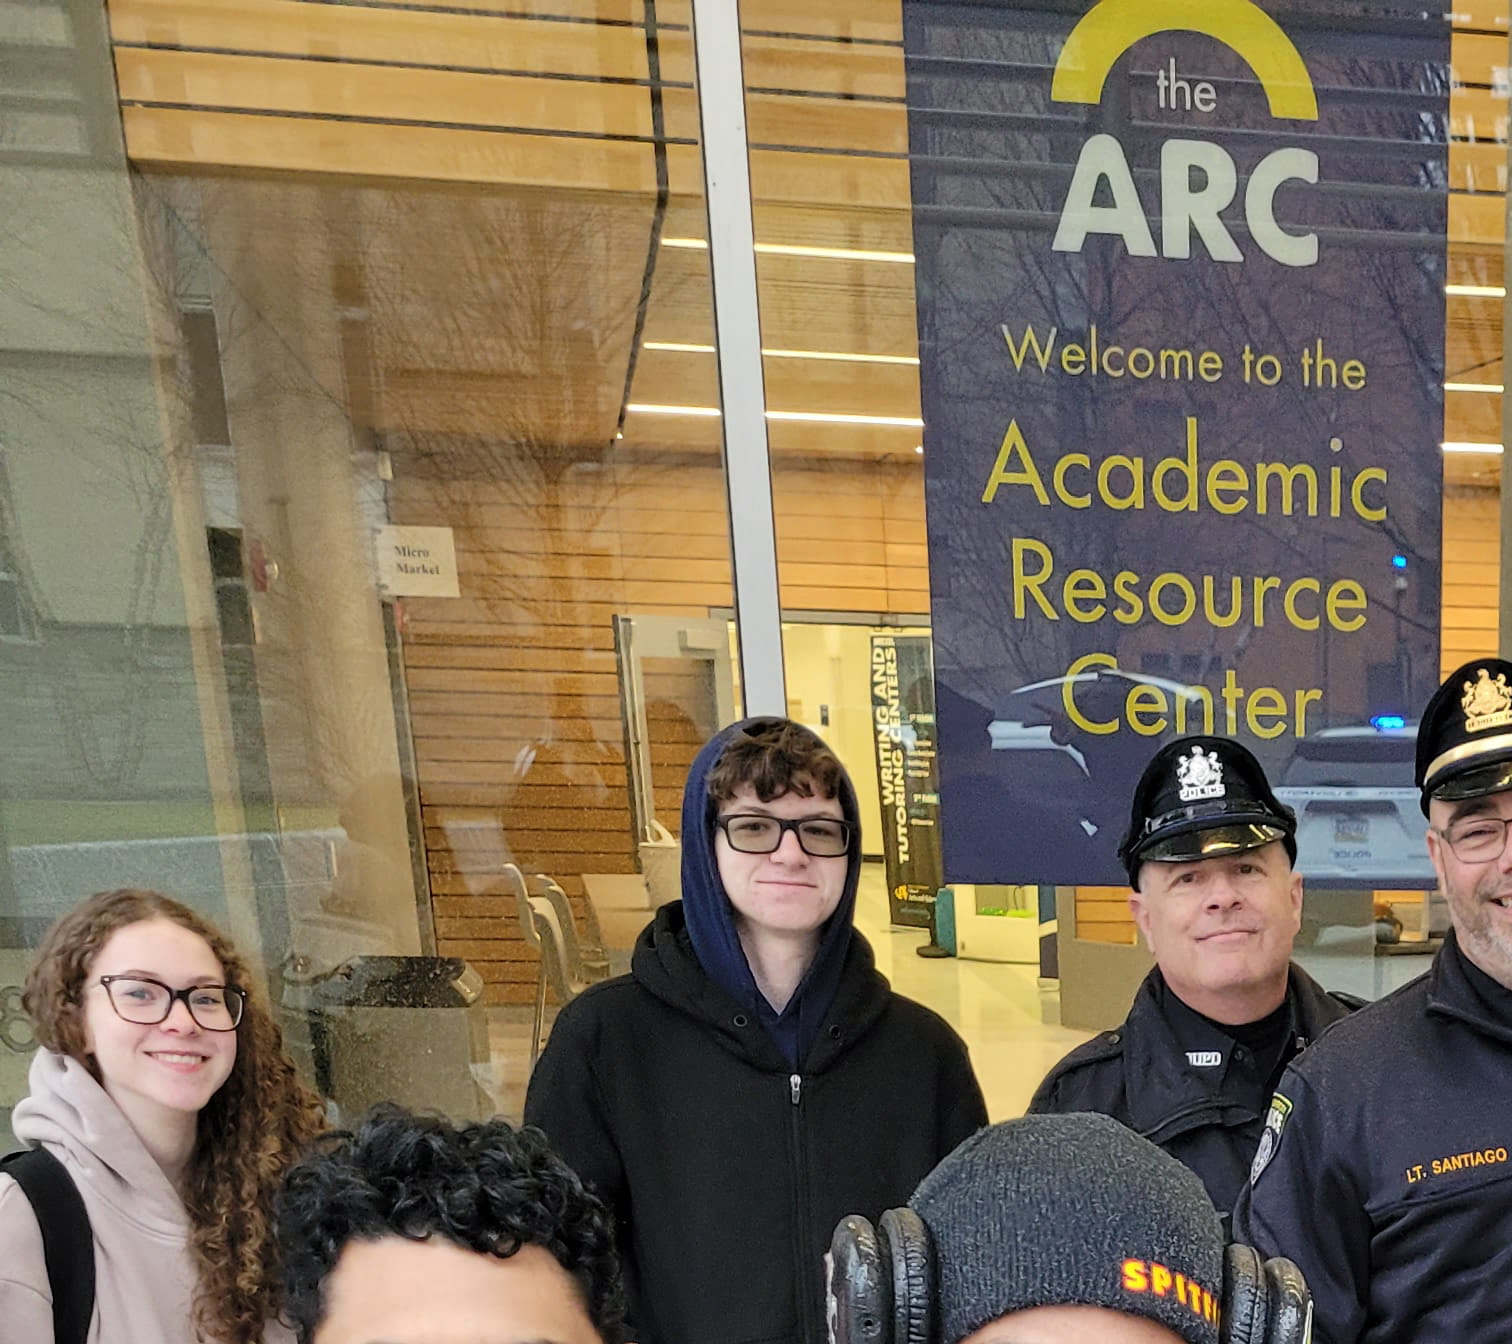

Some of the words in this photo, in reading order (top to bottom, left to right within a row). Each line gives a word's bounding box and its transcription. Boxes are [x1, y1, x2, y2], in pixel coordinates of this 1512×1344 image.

[1156, 57, 1217, 112] the
[1051, 134, 1319, 266] ARC
[1001, 324, 1223, 382] Welcome
[1243, 345, 1283, 386] to
[1301, 338, 1367, 390] the
[981, 417, 1389, 522] Academic
[394, 545, 430, 558] Micro
[396, 563, 441, 575] Market
[1011, 537, 1369, 633] Resource
[873, 652, 888, 699] AND
[886, 648, 902, 740] CENTERS
[1062, 653, 1323, 740] Center
[876, 704, 894, 806] WRITING
[894, 749, 910, 864] TUTORING
[1405, 1164, 1427, 1184] LT.
[1431, 1147, 1508, 1175] SANTIAGO
